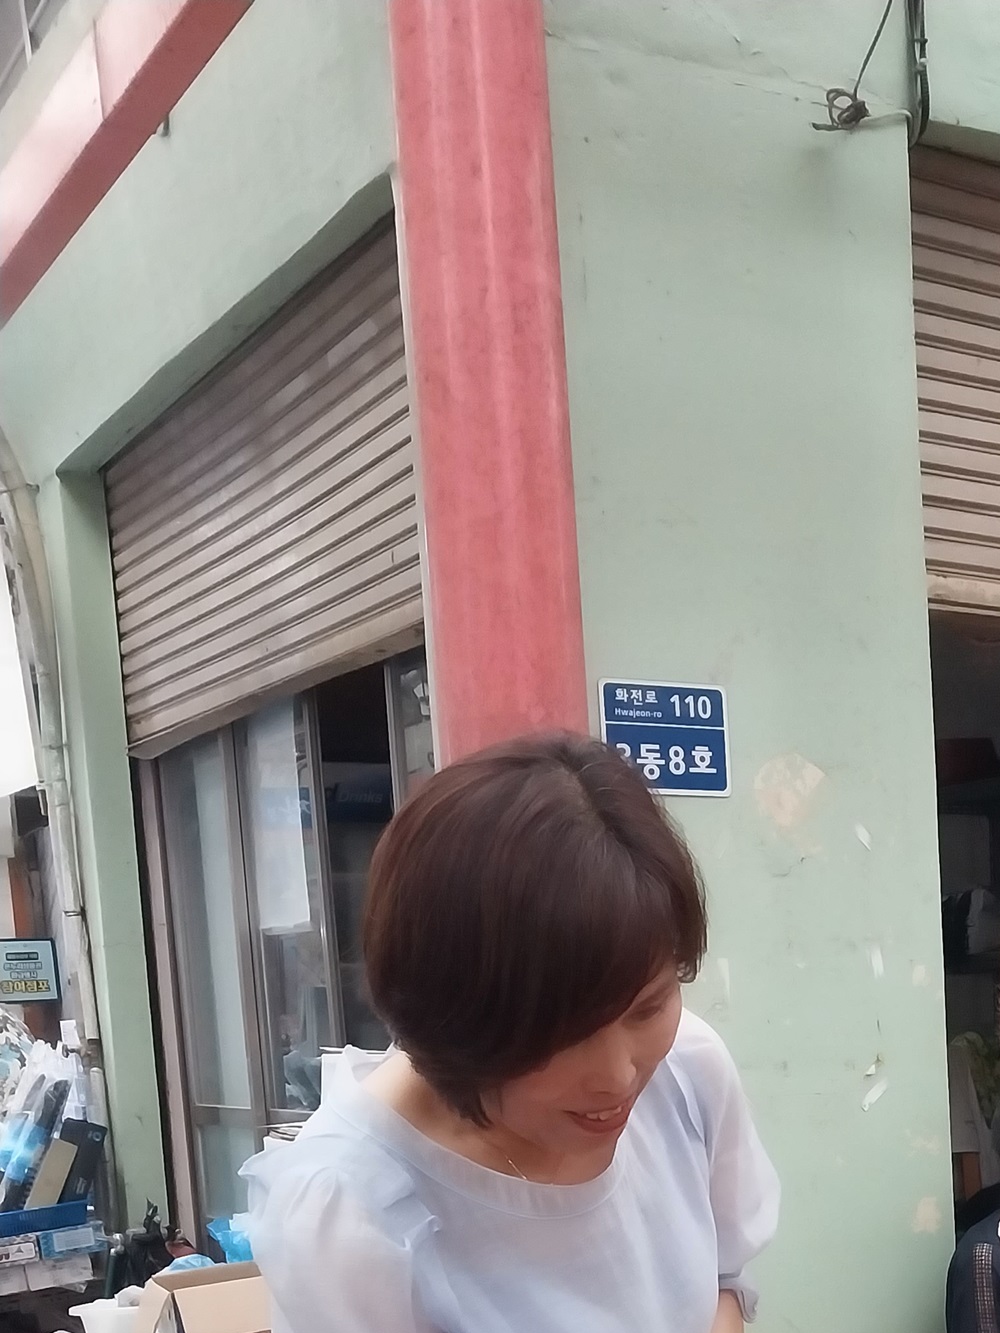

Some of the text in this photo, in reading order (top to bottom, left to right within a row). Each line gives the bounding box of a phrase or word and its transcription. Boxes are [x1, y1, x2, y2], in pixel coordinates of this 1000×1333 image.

[614, 688, 712, 719] 화전로 110
[614, 707, 663, 719] Hwajeon-ro
